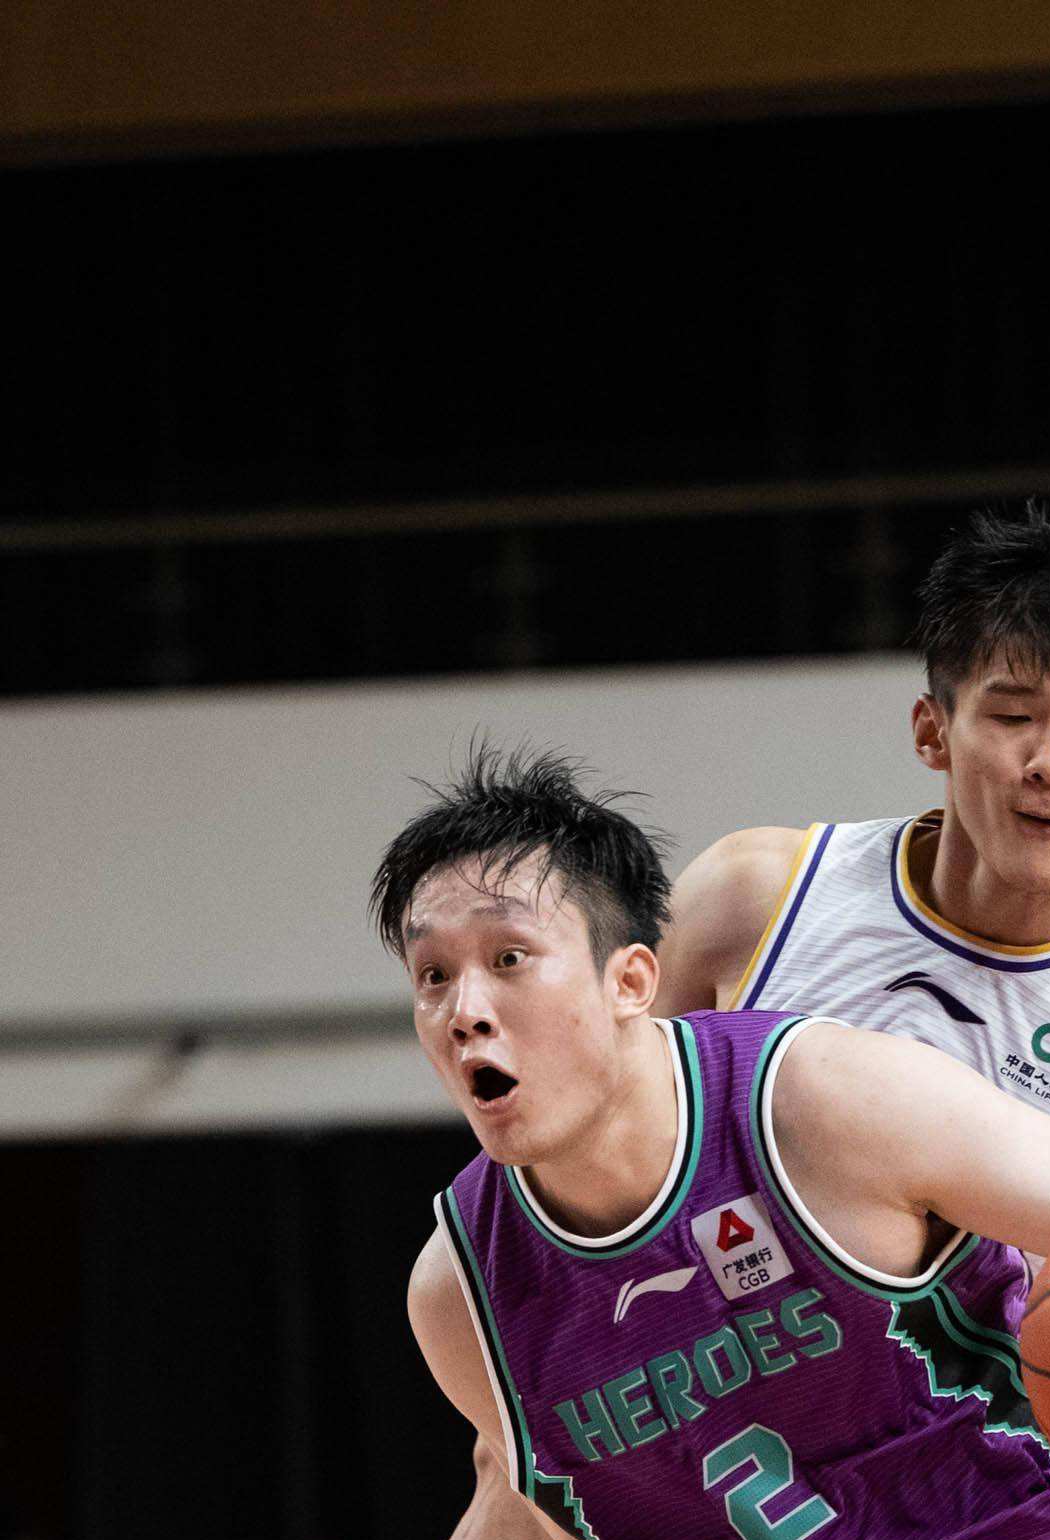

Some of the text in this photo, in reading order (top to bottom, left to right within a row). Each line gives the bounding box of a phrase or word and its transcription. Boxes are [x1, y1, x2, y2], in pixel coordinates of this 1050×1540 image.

[1000, 1066, 1032, 1091] CHINA
[722, 1247, 773, 1280] 广发银行
[738, 1268, 771, 1291] CGB
[552, 1287, 844, 1462] HEROES
